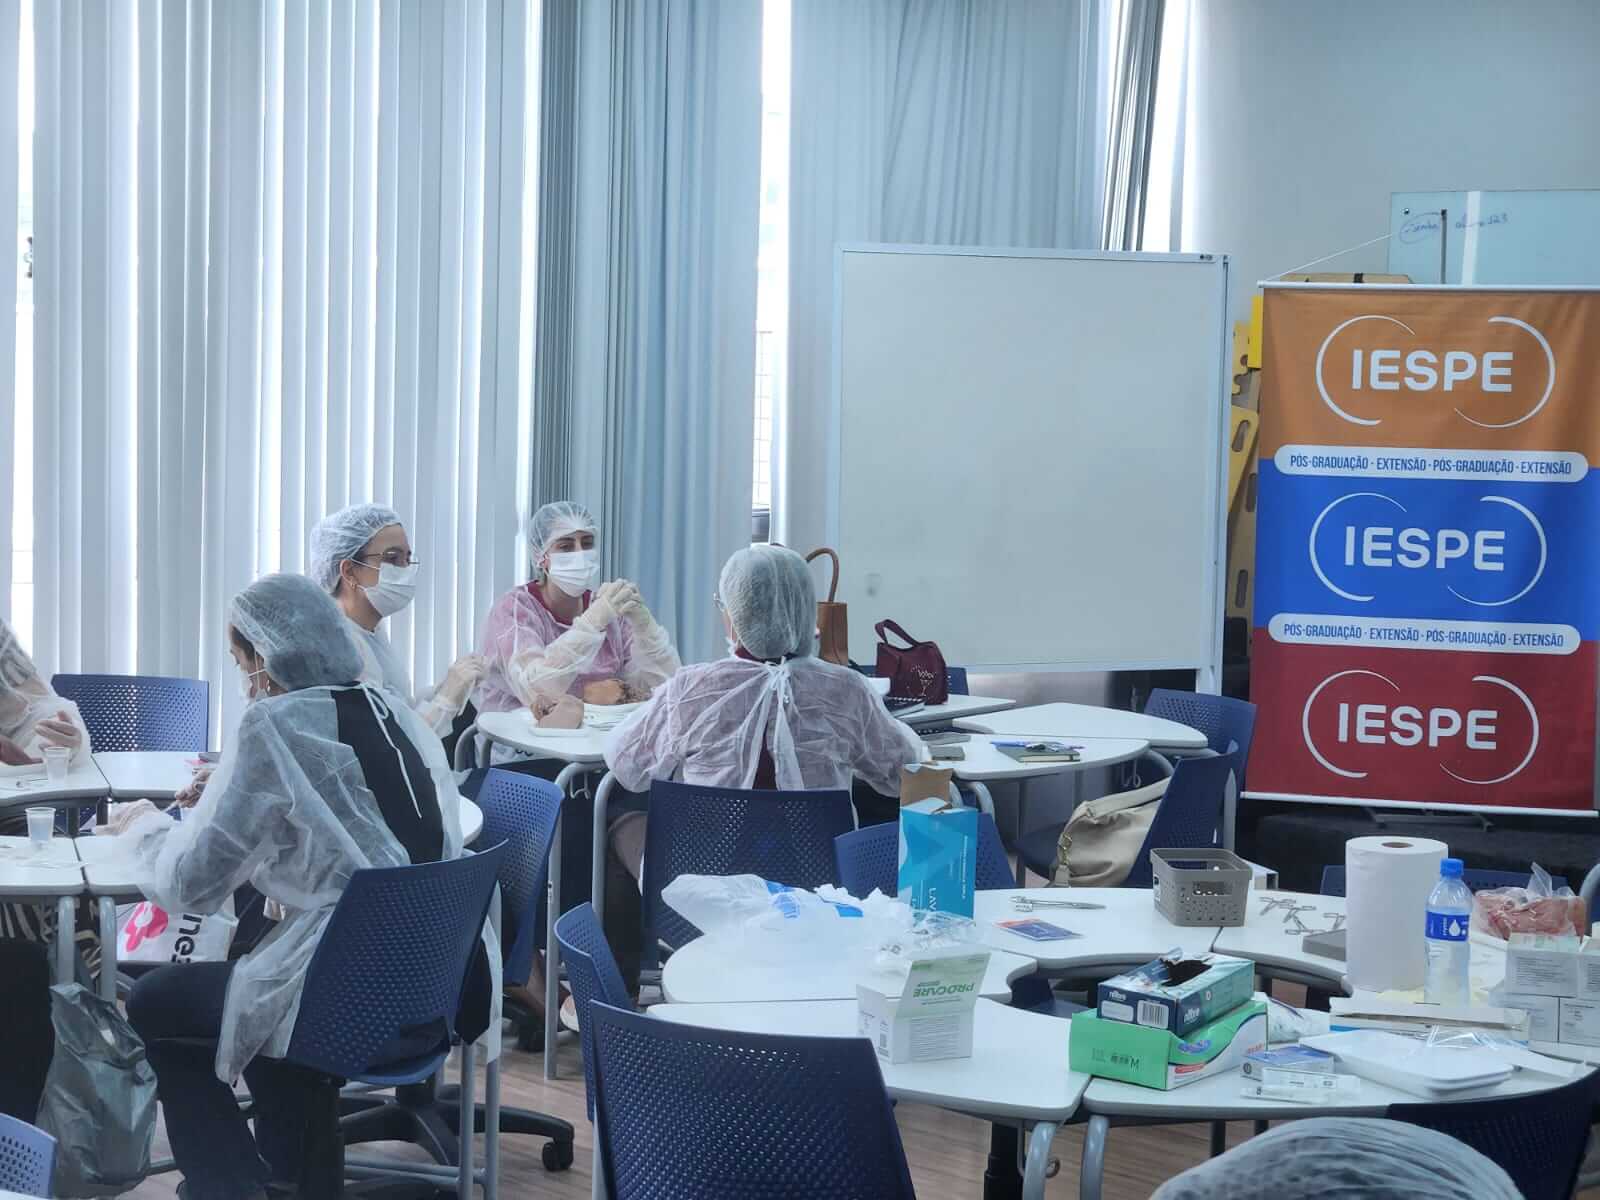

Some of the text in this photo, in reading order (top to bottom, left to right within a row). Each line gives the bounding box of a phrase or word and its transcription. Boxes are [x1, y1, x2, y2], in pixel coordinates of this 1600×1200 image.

[1351, 349, 1514, 393] IESPE
[1290, 454, 1572, 476] PÓS-GRADUAÇÃO EXTENSÃO PÓS-GRADUAÇÃO EXTENSÃO
[1344, 526, 1505, 571] IESPE
[1284, 622, 1564, 647] PÓS-GRADUAÇÃO EXTENSÃO PÓS-GRADUAÇÃO EXTENSÃO
[1338, 703, 1498, 750] IESPE
[928, 887, 937, 911] LAV
